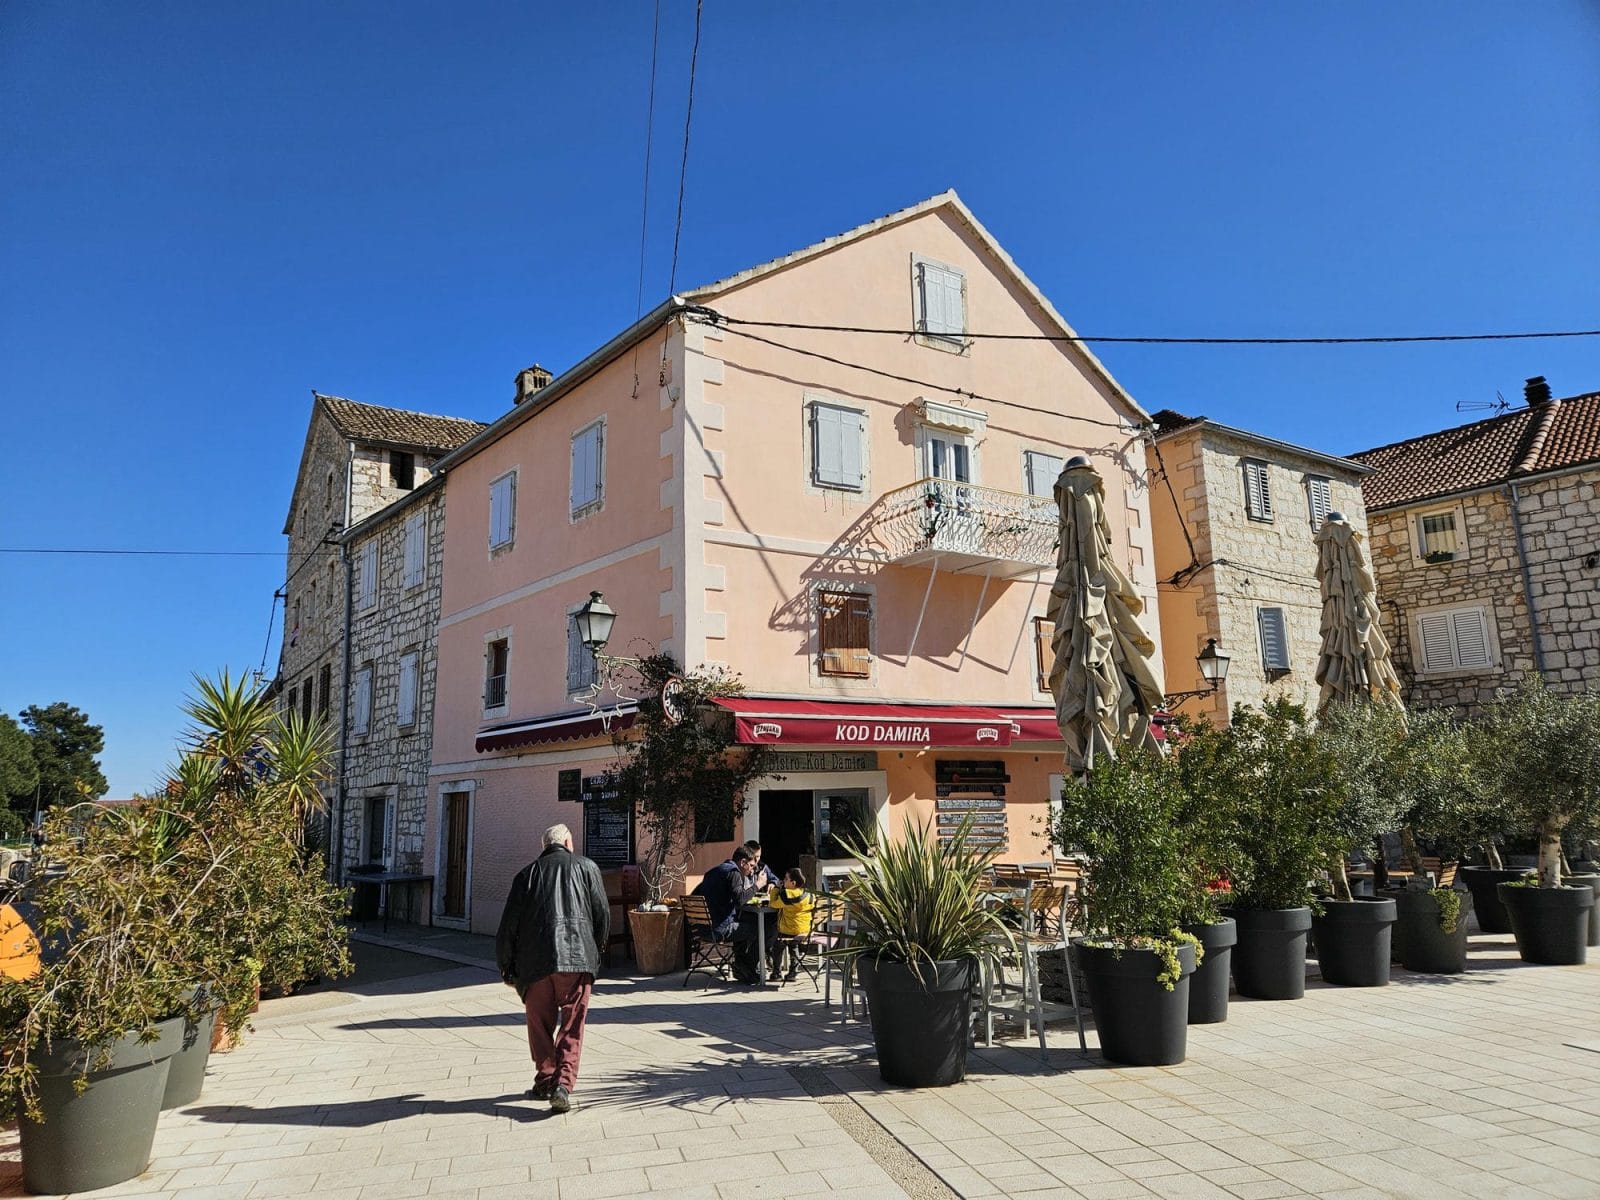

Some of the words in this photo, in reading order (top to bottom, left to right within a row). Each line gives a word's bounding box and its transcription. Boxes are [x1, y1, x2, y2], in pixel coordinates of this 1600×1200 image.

[835, 725, 870, 741] KOD
[873, 726, 931, 742] DAMIRA
[768, 753, 800, 770] Bistro
[806, 753, 826, 770] Kod
[832, 754, 866, 770] Damira
